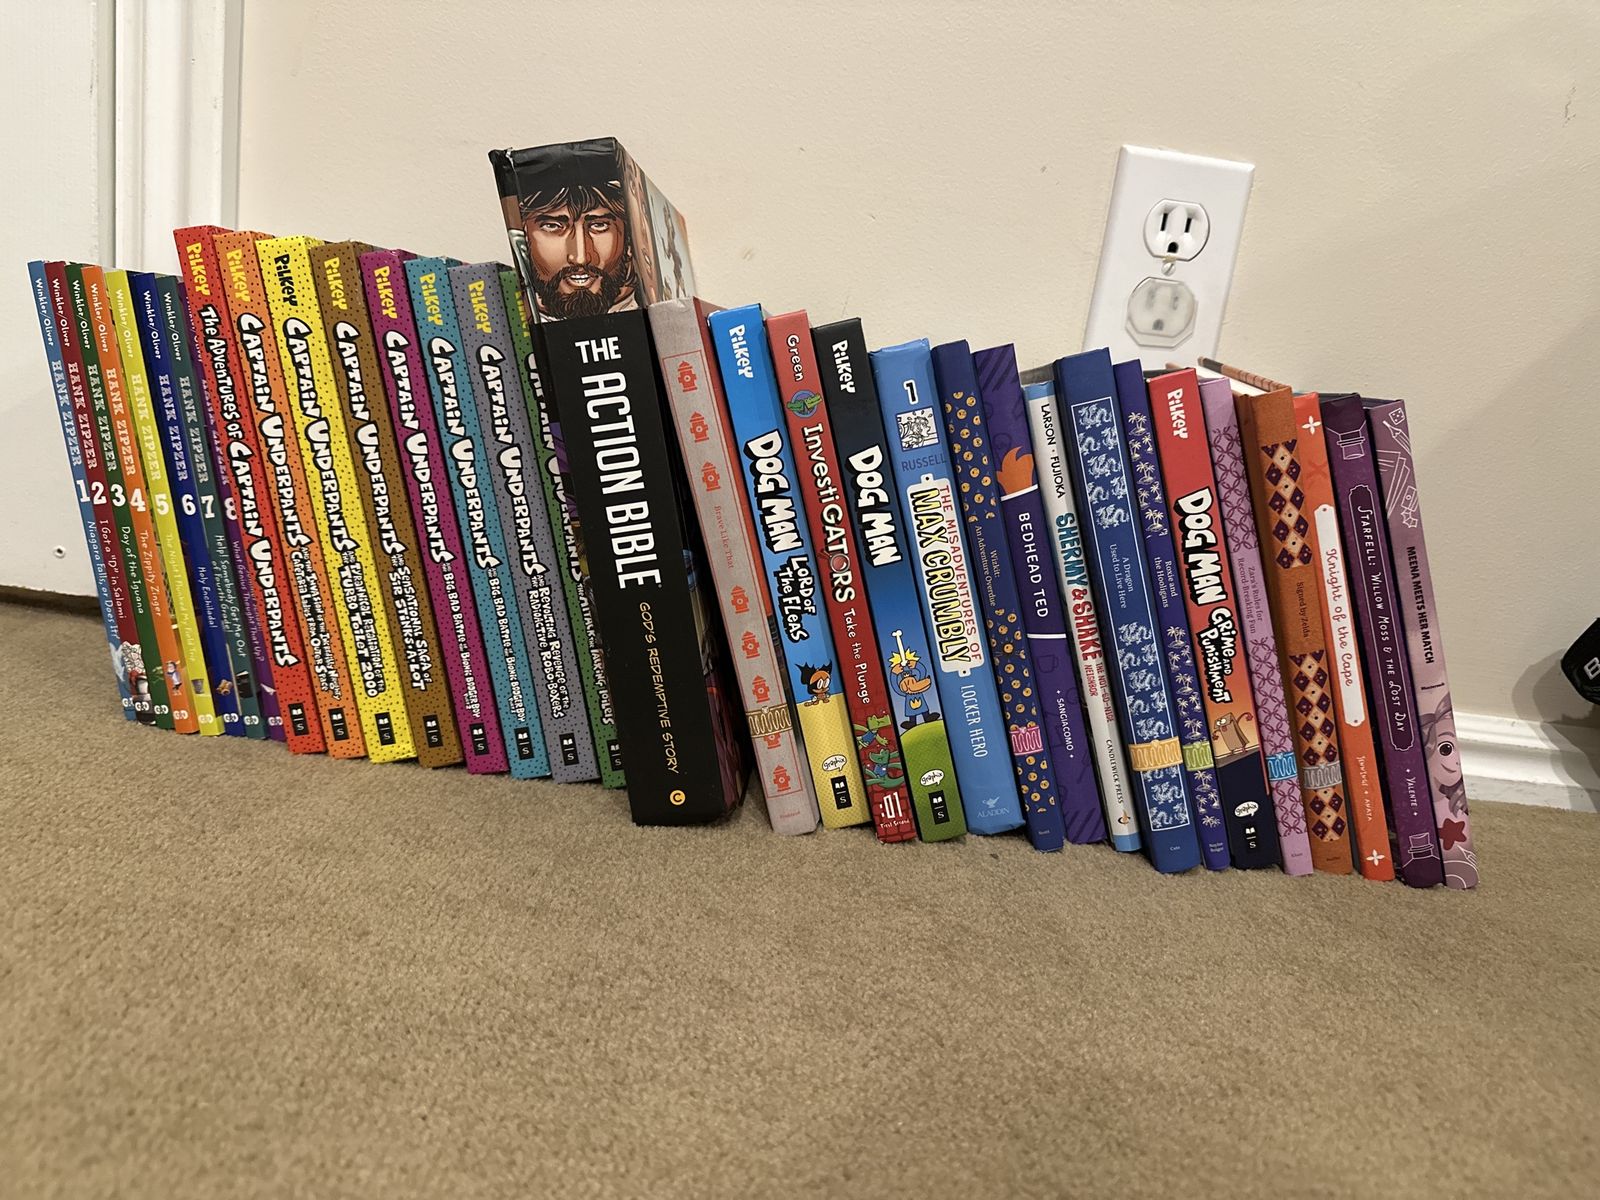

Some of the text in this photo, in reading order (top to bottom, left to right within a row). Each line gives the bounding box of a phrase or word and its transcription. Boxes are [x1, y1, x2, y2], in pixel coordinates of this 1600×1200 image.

[35, 277, 54, 346] Winkler/Oliver
[52, 278, 71, 347] Winkler/Oliver
[72, 279, 90, 349] Winkler/Oliver
[90, 283, 108, 353] Winkler/Oliver
[115, 289, 134, 358] Winkler/Oliver
[143, 291, 161, 359] Winkler/Oliver
[163, 292, 181, 361] Winkler/Oliver
[787, 334, 804, 382] Green
[904, 380, 918, 404] 1
[51, 360, 82, 466] HANK ZIPZER
[68, 362, 98, 470] HANK ZIPZER
[87, 365, 117, 471] HANK ZIPZER
[106, 368, 136, 476] HANK ZIPZER
[131, 374, 161, 481] HANK ZIPZER
[159, 374, 188, 481] HANK ZIPZER
[179, 377, 197, 423] HANK
[189, 428, 209, 483] ZIPZER
[261, 416, 313, 547] UNDERPANTS
[306, 420, 360, 551] UNDERPANTS
[575, 336, 662, 590] THE ACTION BIBLE
[901, 454, 948, 472] RUSSELL
[1041, 404, 1066, 499] LARSON FUJIOKA
[76, 480, 91, 502] 1
[91, 482, 106, 504] 2
[110, 484, 125, 506] 3
[130, 488, 146, 511] 4
[154, 493, 170, 515] 5
[182, 494, 196, 515] 6
[200, 306, 218, 336] The
[251, 540, 300, 667] UNDERPANTS
[201, 495, 216, 519] 7
[224, 498, 238, 520] 8
[357, 424, 406, 555] UNDERPANTS
[500, 446, 549, 576] UNDERPANTS
[747, 431, 802, 553] DOG MAN
[848, 445, 902, 567] DOG MAN
[101, 526, 112, 543] Got
[233, 541, 242, 559] What
[406, 432, 455, 563] UNDERPANTS
[448, 593, 460, 613] BAD
[451, 438, 500, 569] UNDERPANTS
[494, 598, 505, 616] BAD
[1178, 488, 1227, 605] DOG MAN
[87, 521, 114, 623] Niagara or Does
[111, 577, 117, 585] in
[121, 526, 144, 614] Day of the Iguana
[140, 530, 161, 617] The Zippity Zinger
[197, 566, 218, 628] Holy Enchilada!
[211, 560, 232, 634] of Fourth Grade!
[215, 535, 246, 657] Help! Somebody Get Me Out
[235, 560, 248, 590] Genius
[910, 488, 972, 664] MAX CRUMBLY
[938, 485, 982, 661] THE MISADVENTURES OF
[975, 525, 996, 607] An Adventure Overdue
[1018, 512, 1049, 619] BEDHEAD TED
[1056, 513, 1102, 661] SHERMY & SHAKE
[1110, 544, 1127, 609] Used to Live Here
[1124, 564, 1134, 592] Dragon
[1154, 557, 1169, 608] the Hooligans
[1165, 560, 1178, 597] Roxie and
[113, 588, 127, 619] Salami
[243, 592, 253, 624] Thought
[248, 626, 258, 646] That
[340, 566, 378, 697] TURBO 2000
[843, 608, 856, 639] Take
[1253, 589, 1264, 621] Rules for
[1299, 606, 1307, 617] by
[1326, 549, 1352, 687] Knight of the Cape
[1357, 506, 1407, 733] STARFELL: WILLOW MOSS THE LOST DAY
[1407, 546, 1435, 664] MEENA MEETS HER MATCH
[416, 639, 432, 672] SAGA
[851, 642, 862, 661] the
[855, 662, 871, 705] Plunge
[1084, 664, 1099, 697] NEIGHBOR
[639, 602, 680, 774] GOD'S REDEMPTIVE STORY
[960, 683, 988, 759] LOCKER HERO
[1056, 698, 1074, 752] SANGIACOMO
[1106, 740, 1125, 804] CANDLEWICK PRESS
[1406, 776, 1418, 807] VALENTE
